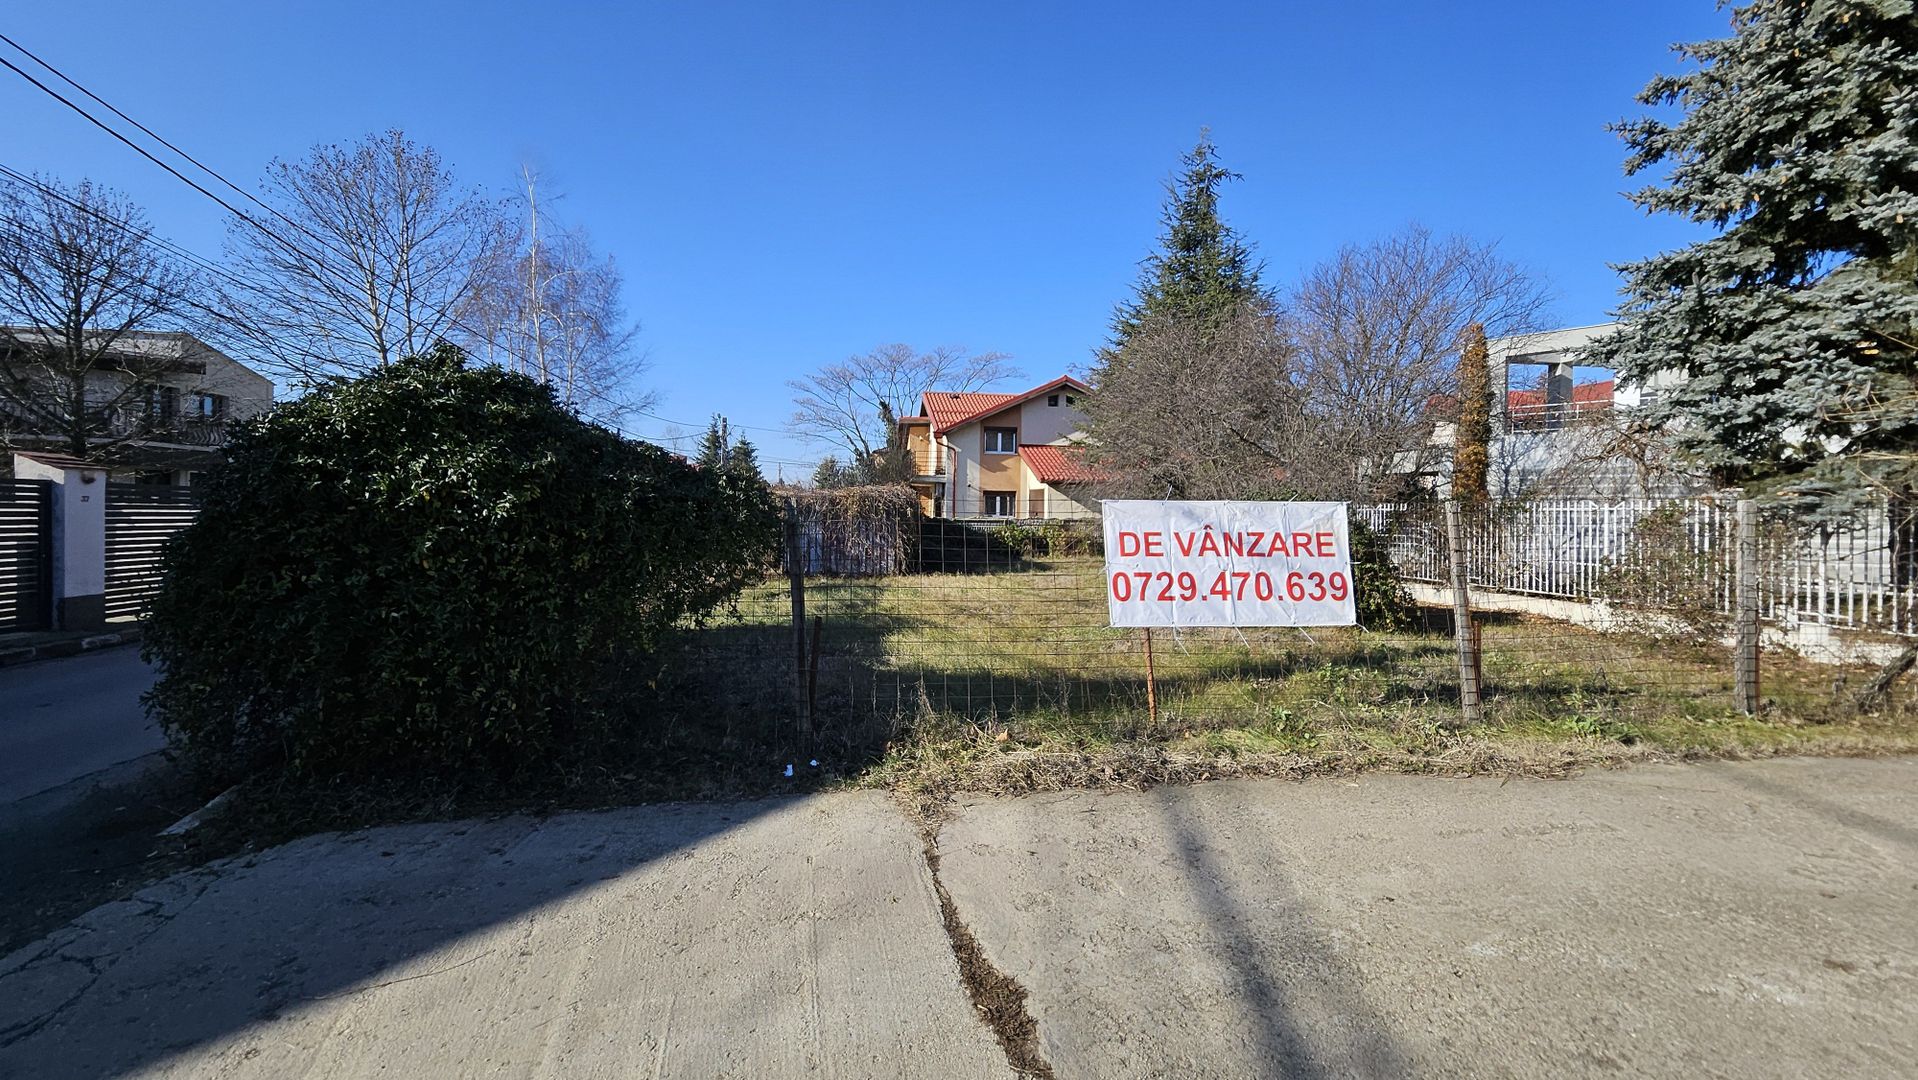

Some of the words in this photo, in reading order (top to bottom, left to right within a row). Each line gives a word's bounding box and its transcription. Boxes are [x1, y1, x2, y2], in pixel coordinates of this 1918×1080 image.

[1118, 531, 1164, 557] DE
[1173, 524, 1336, 557] VÂNZARE
[1112, 571, 1348, 602] 0729.470.639
